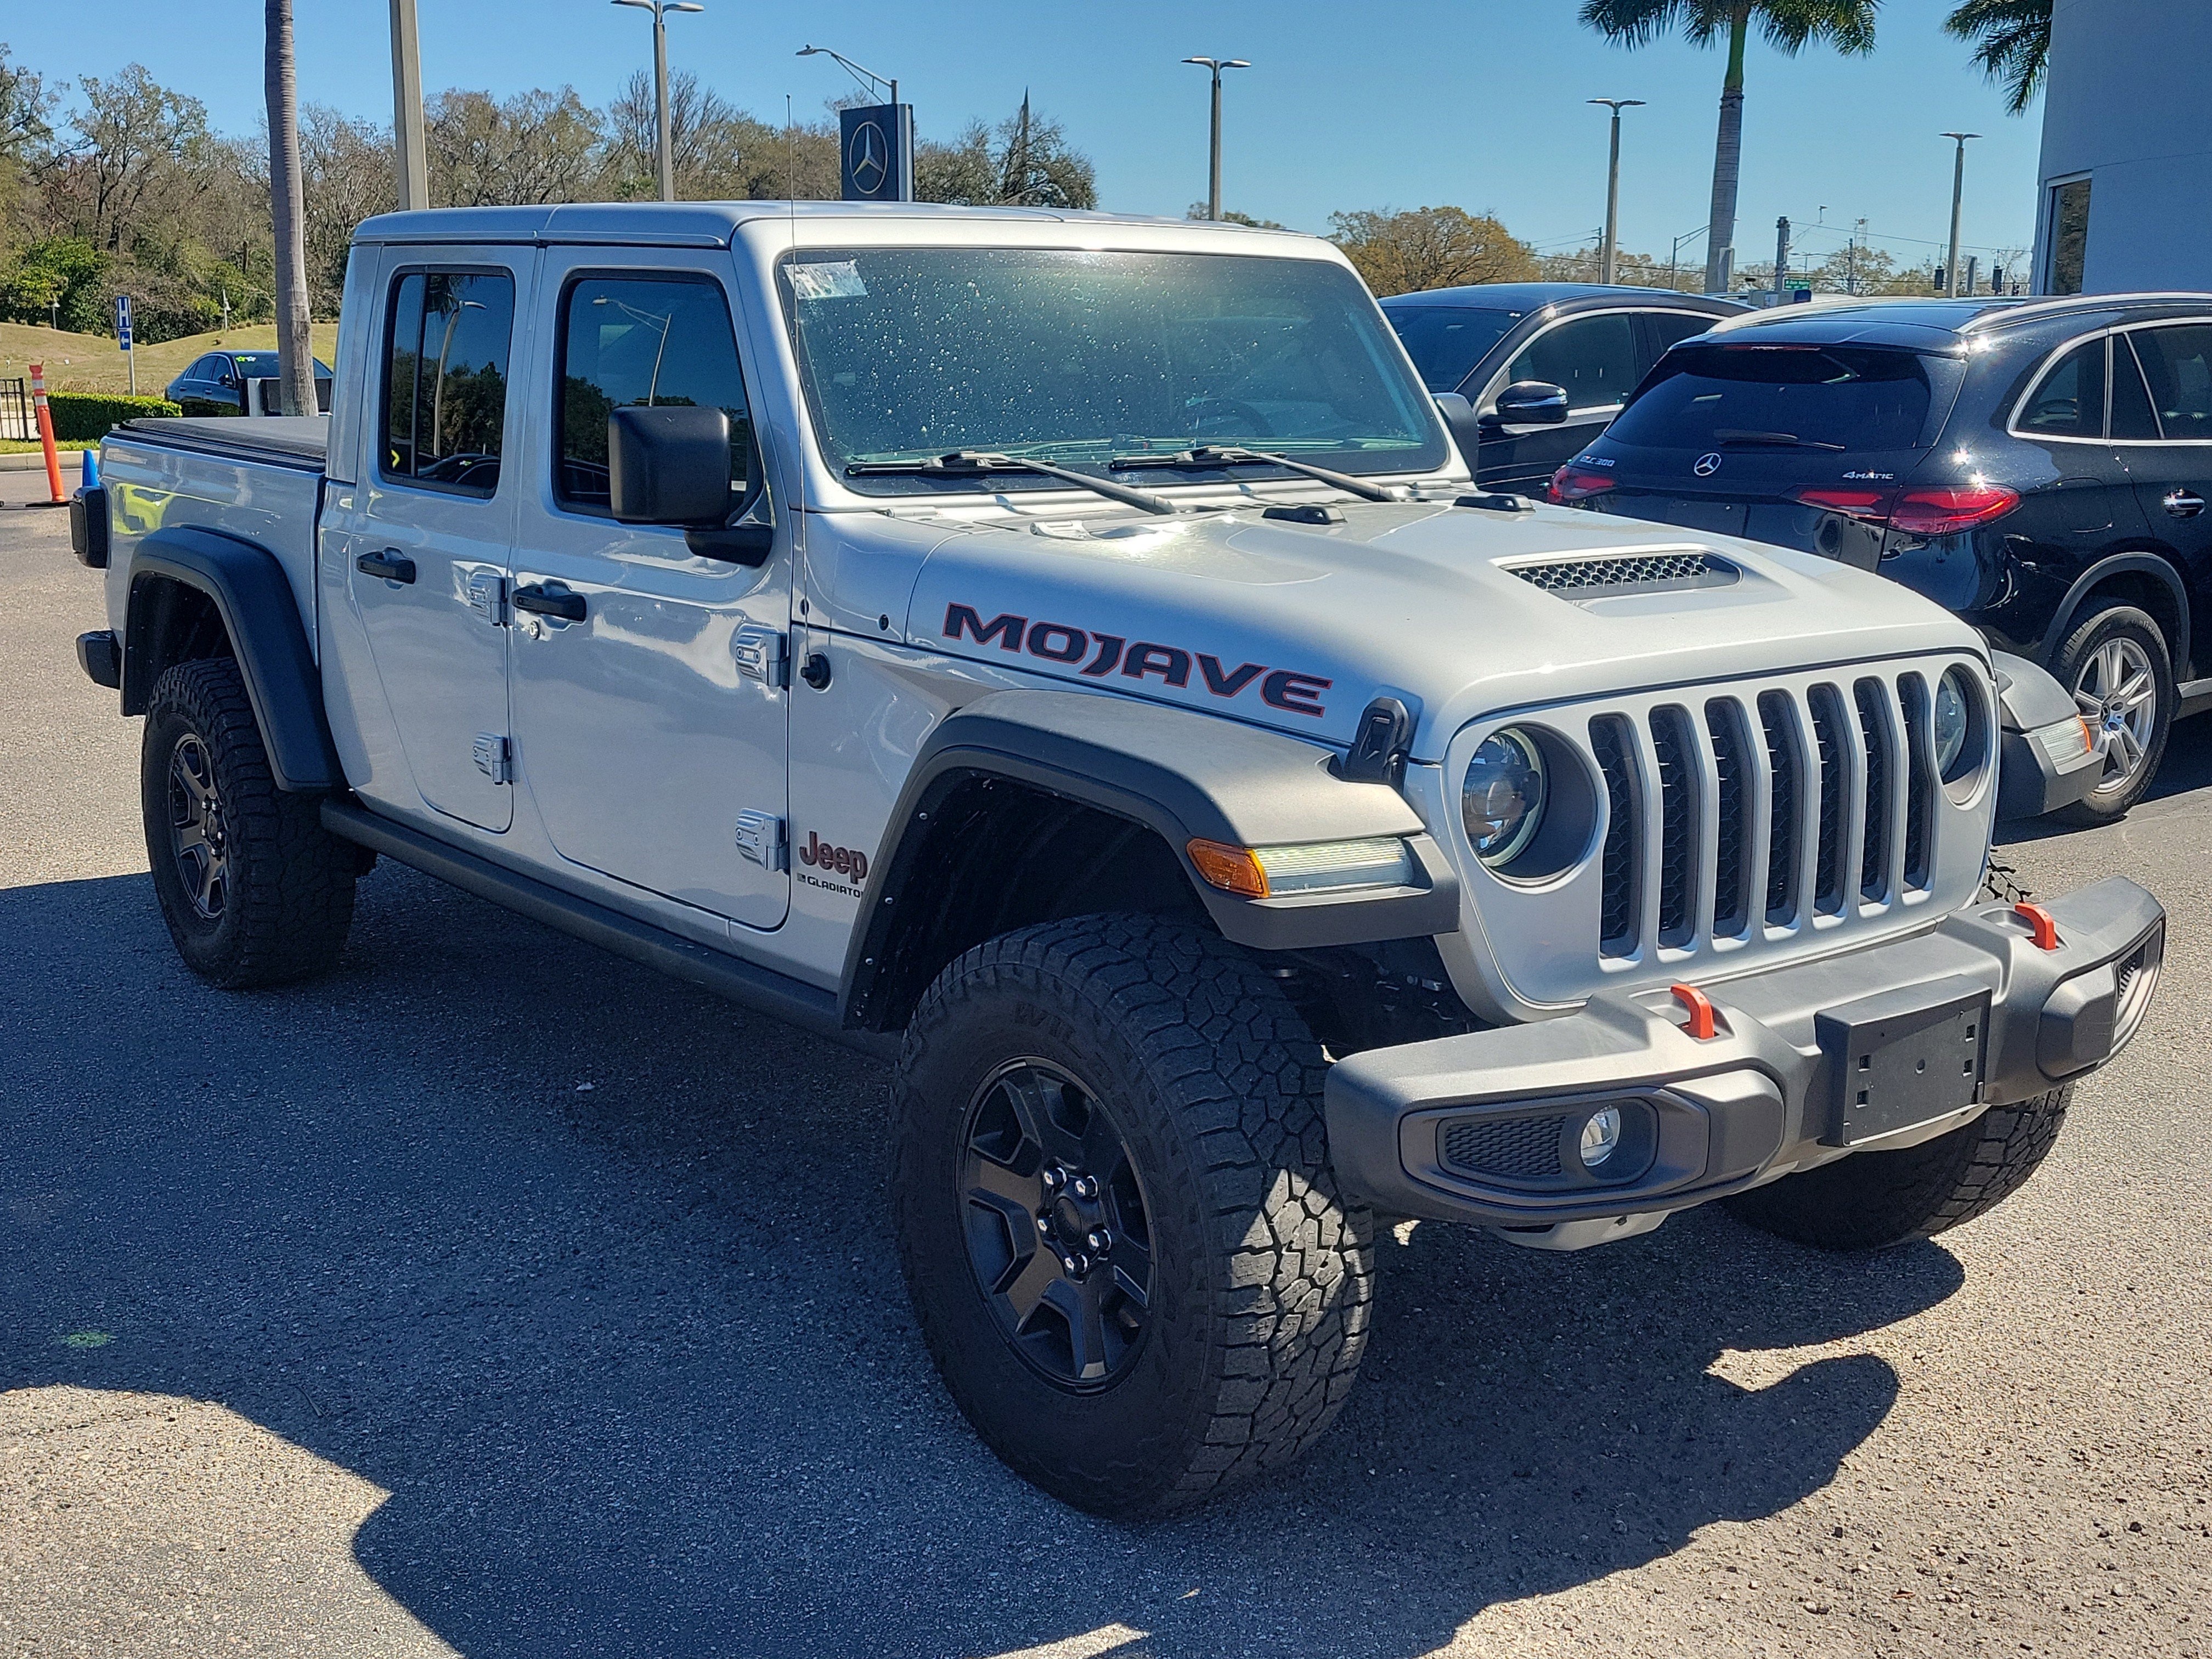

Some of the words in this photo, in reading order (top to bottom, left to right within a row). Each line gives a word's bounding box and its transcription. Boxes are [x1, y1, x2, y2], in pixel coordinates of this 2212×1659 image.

[118, 298, 129, 327] H
[1595, 459, 1616, 467] 300
[1842, 471, 1894, 479] 4MATIC
[942, 602, 1334, 718] MOJAVE
[799, 831, 868, 885] Jeep
